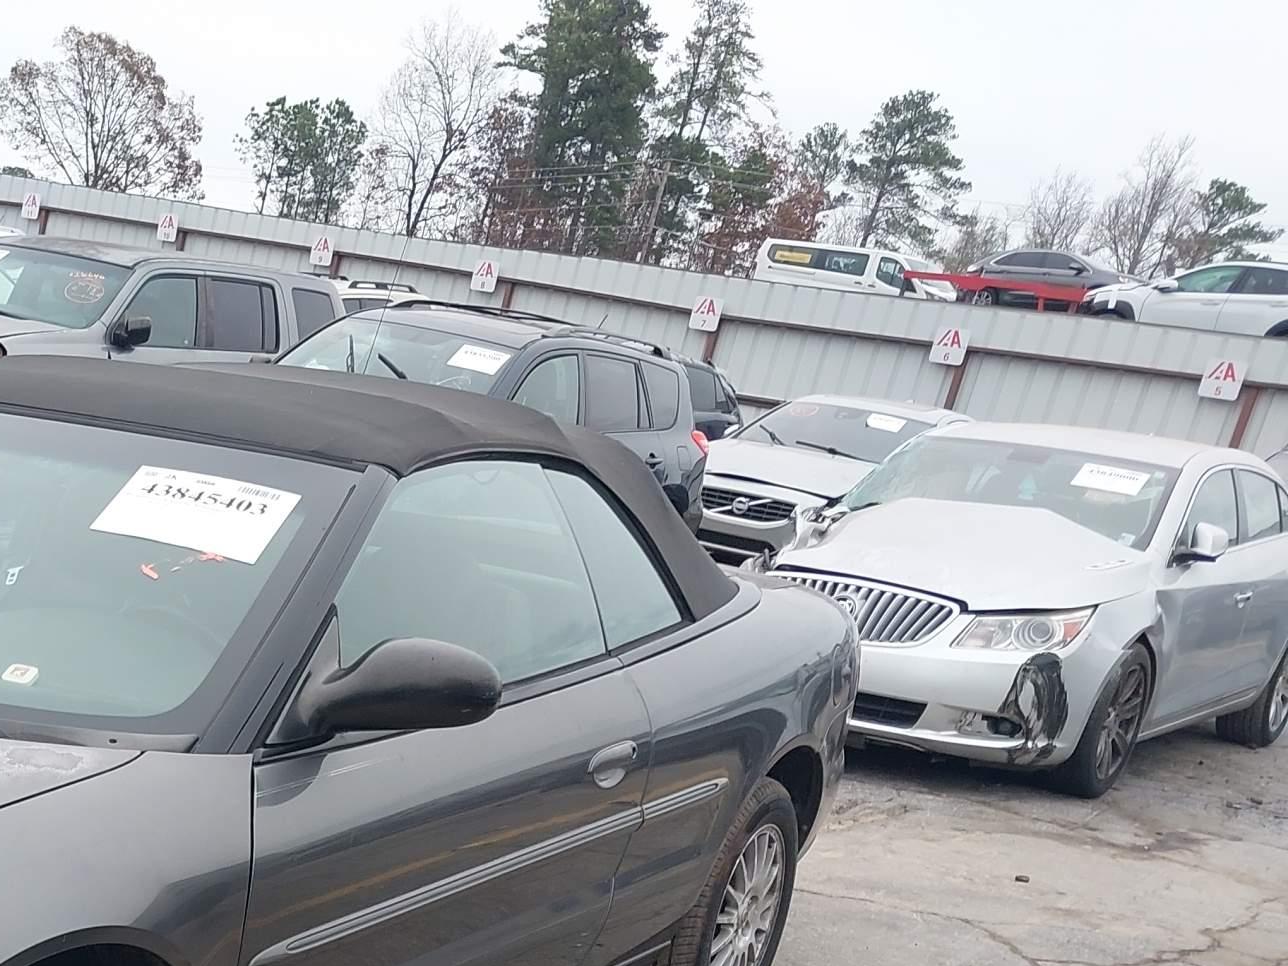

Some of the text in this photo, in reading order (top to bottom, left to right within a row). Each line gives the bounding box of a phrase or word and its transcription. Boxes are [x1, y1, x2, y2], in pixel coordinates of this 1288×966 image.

[318, 255, 324, 263] 9
[700, 319, 707, 328] 7
[943, 352, 950, 361] 6
[1214, 386, 1222, 396] 5
[140, 482, 268, 516] 43845403
